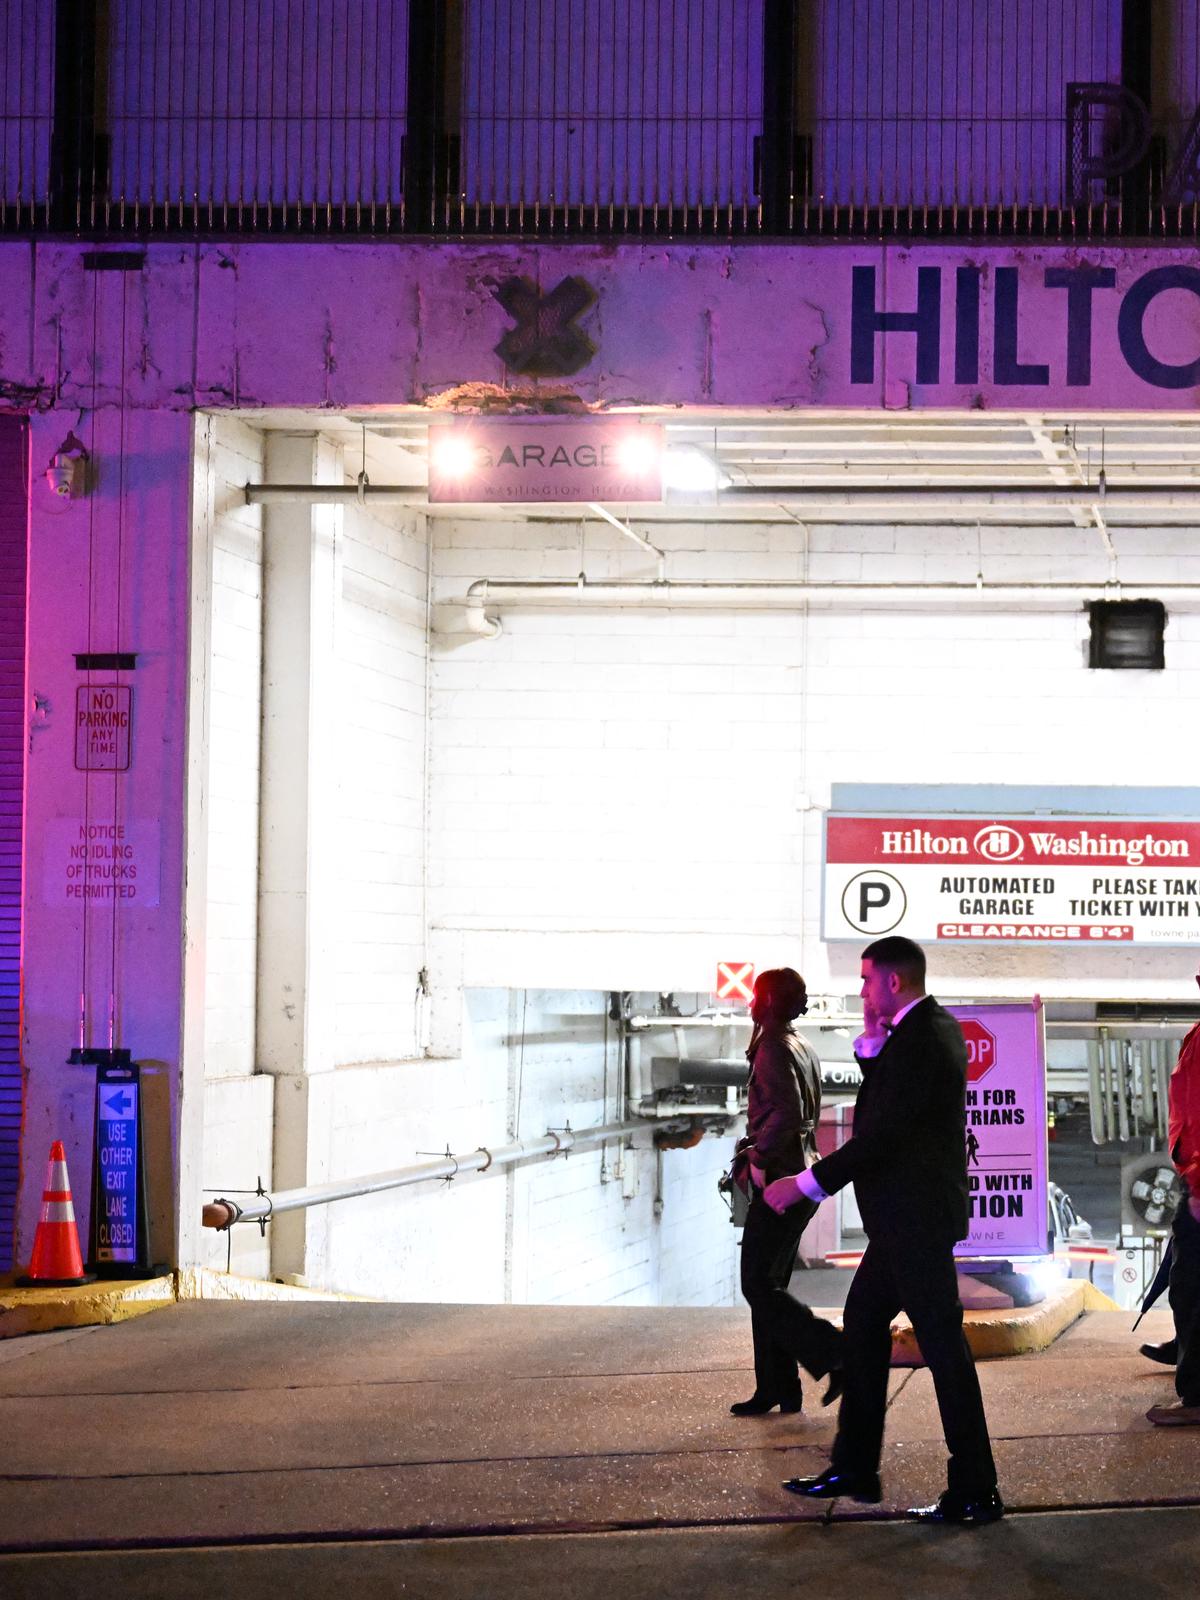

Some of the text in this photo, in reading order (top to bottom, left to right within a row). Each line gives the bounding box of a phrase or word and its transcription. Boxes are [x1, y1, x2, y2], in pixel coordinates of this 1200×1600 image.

[93, 694, 114, 709] NO
[79, 711, 128, 727] PARKING
[91, 731, 113, 740] ANY
[90, 742, 116, 753] TIME
[79, 825, 125, 838] NOTICE
[70, 845, 133, 859] NO IDLING
[882, 831, 969, 856] Hilton
[1029, 832, 1190, 865] Washington
[66, 864, 137, 878] OF TRUCKS
[66, 885, 136, 898] PERMITTED
[939, 877, 1055, 894] AUTOMATED
[1092, 878, 1158, 895] PLEASE
[859, 881, 891, 923] P
[959, 899, 1035, 916] GARAGE
[1069, 899, 1135, 917] TICKET
[1139, 900, 1190, 917] WITH
[941, 925, 1081, 938] CLEARANCE
[1150, 929, 1184, 937] towne
[983, 1089, 1016, 1105] FOR
[965, 1108, 1025, 1125] TRIANS
[108, 1123, 126, 1141] USE
[101, 1147, 133, 1165] OTHER
[106, 1171, 128, 1189] EXIT
[985, 1174, 1032, 1191] WITH
[105, 1197, 127, 1217] LANE
[968, 1194, 1023, 1218] TION
[100, 1223, 132, 1244] CLOSED
[969, 1232, 1006, 1240] WNE
